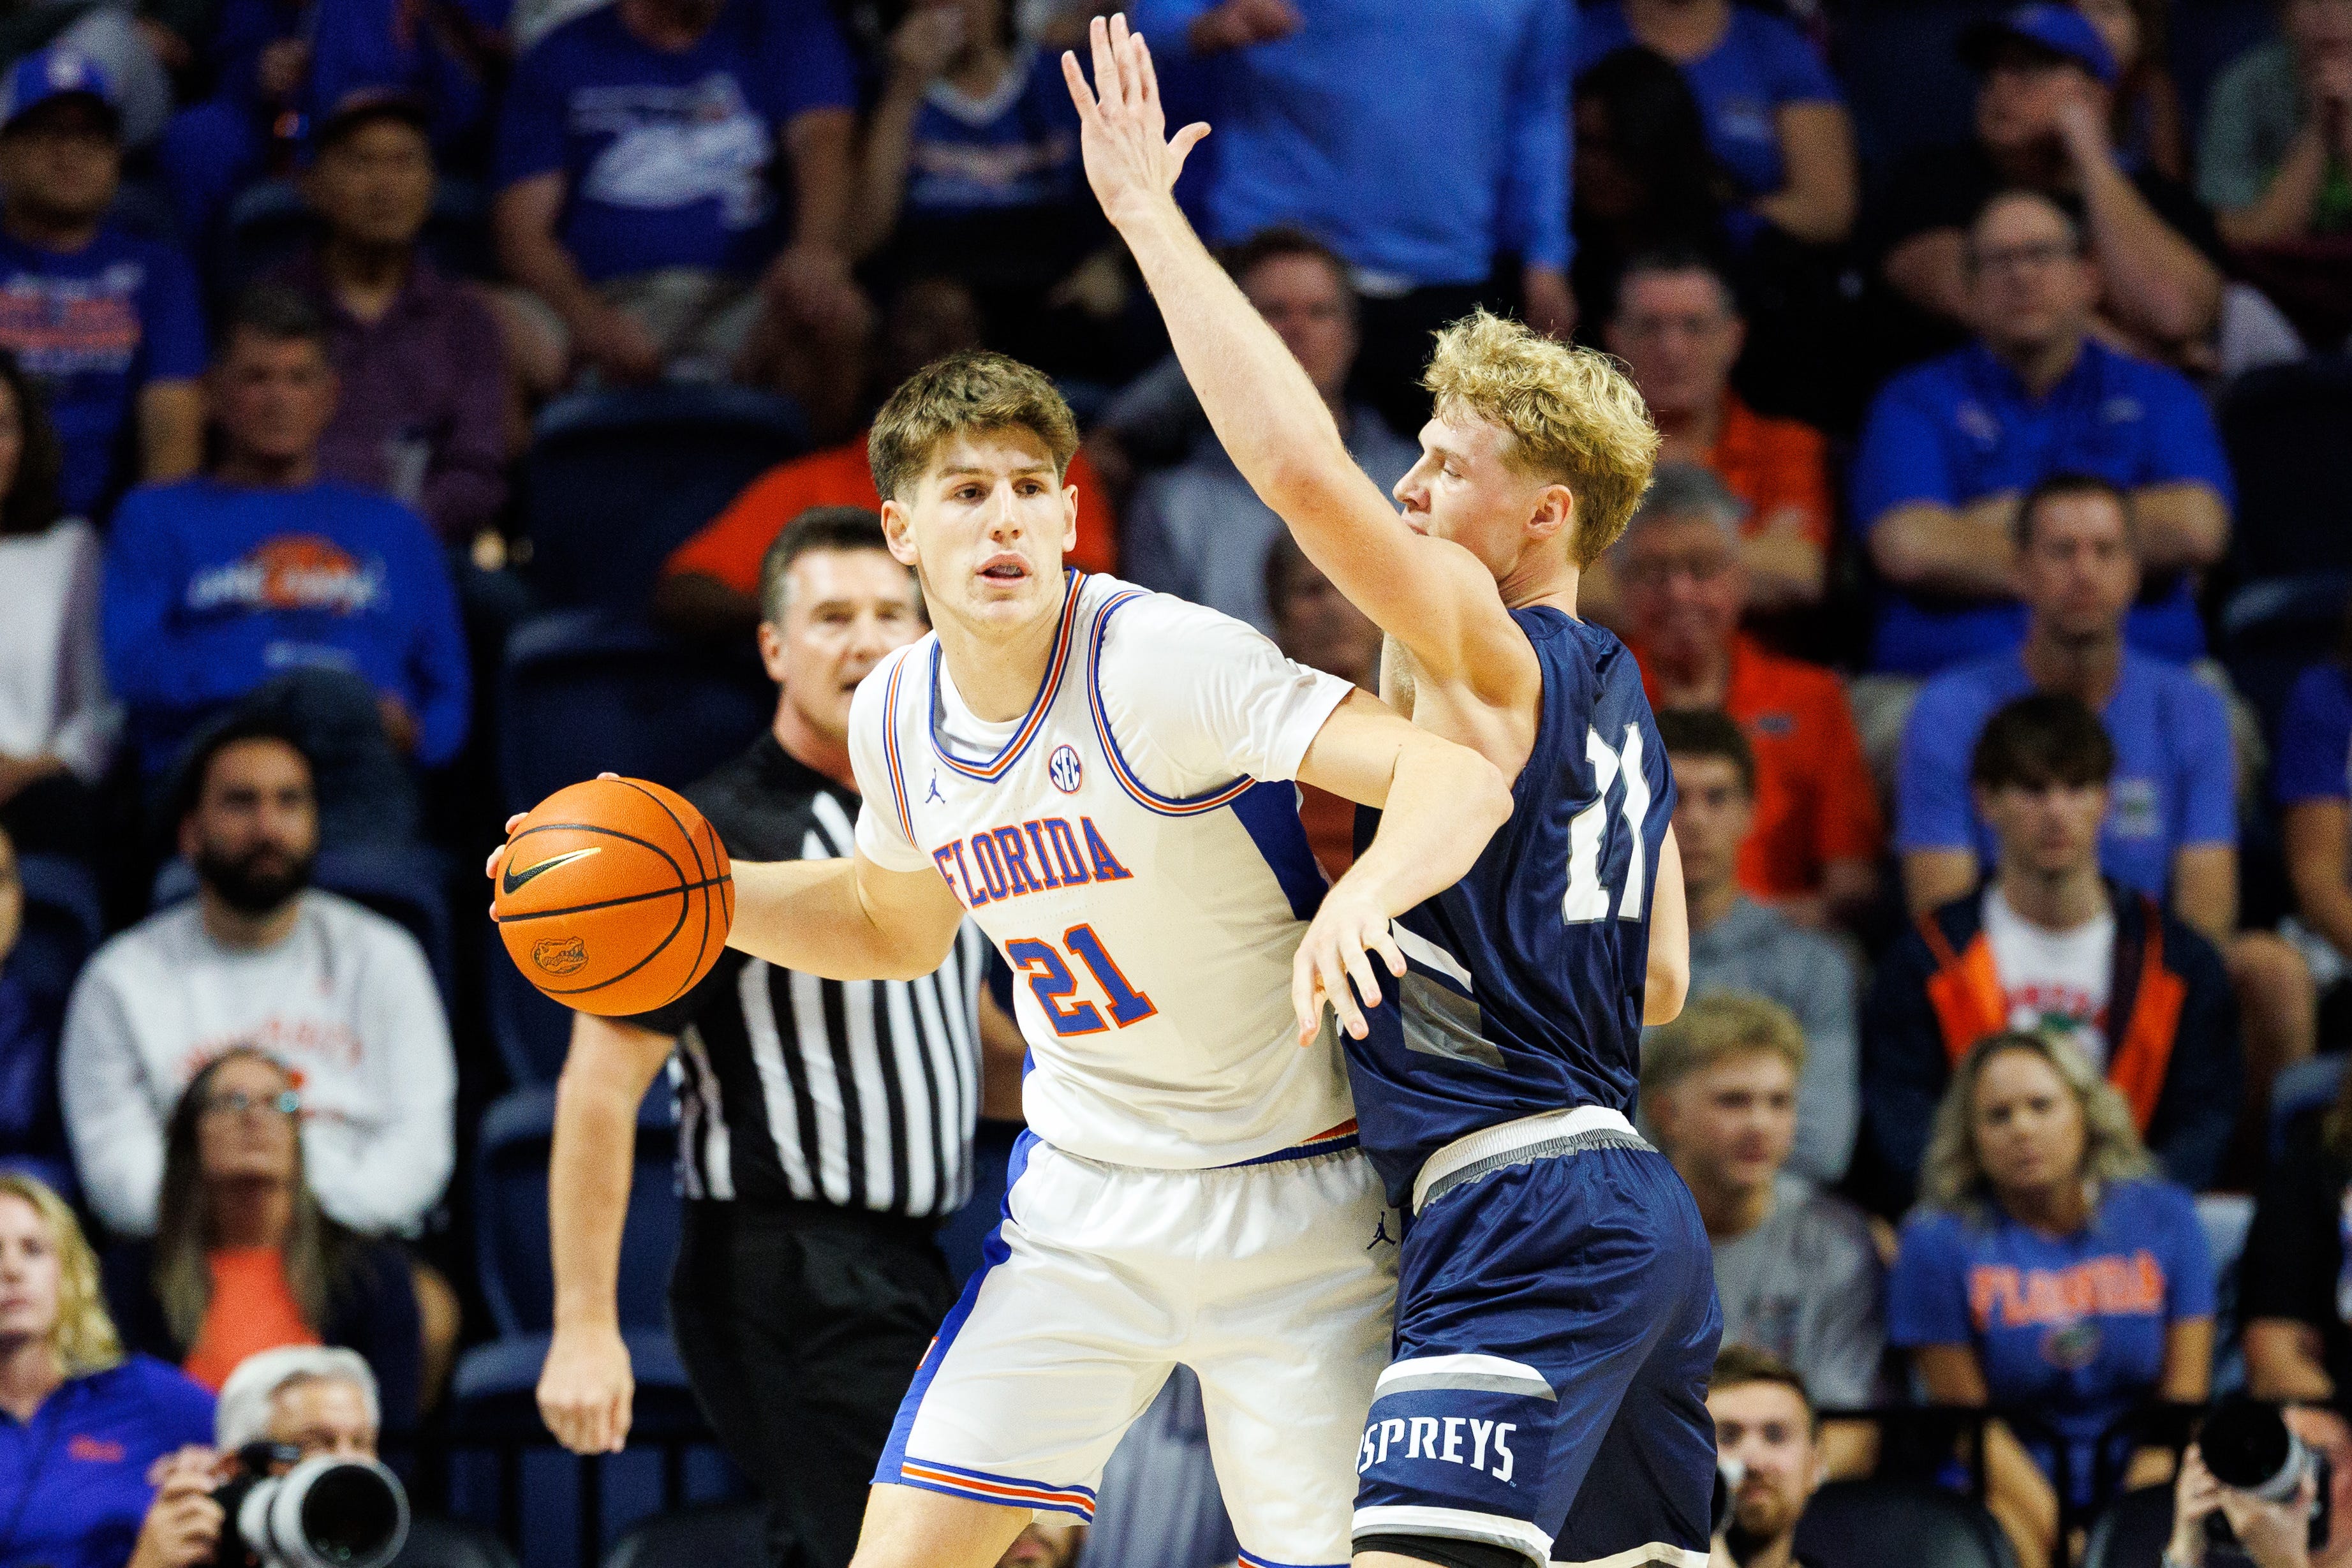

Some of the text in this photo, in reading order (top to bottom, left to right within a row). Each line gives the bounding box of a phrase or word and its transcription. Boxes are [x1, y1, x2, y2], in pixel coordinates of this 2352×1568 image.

[1050, 747, 1081, 792] SEC
[1005, 923, 1158, 1037] 21
[1355, 1417, 1517, 1483] SPREYS
